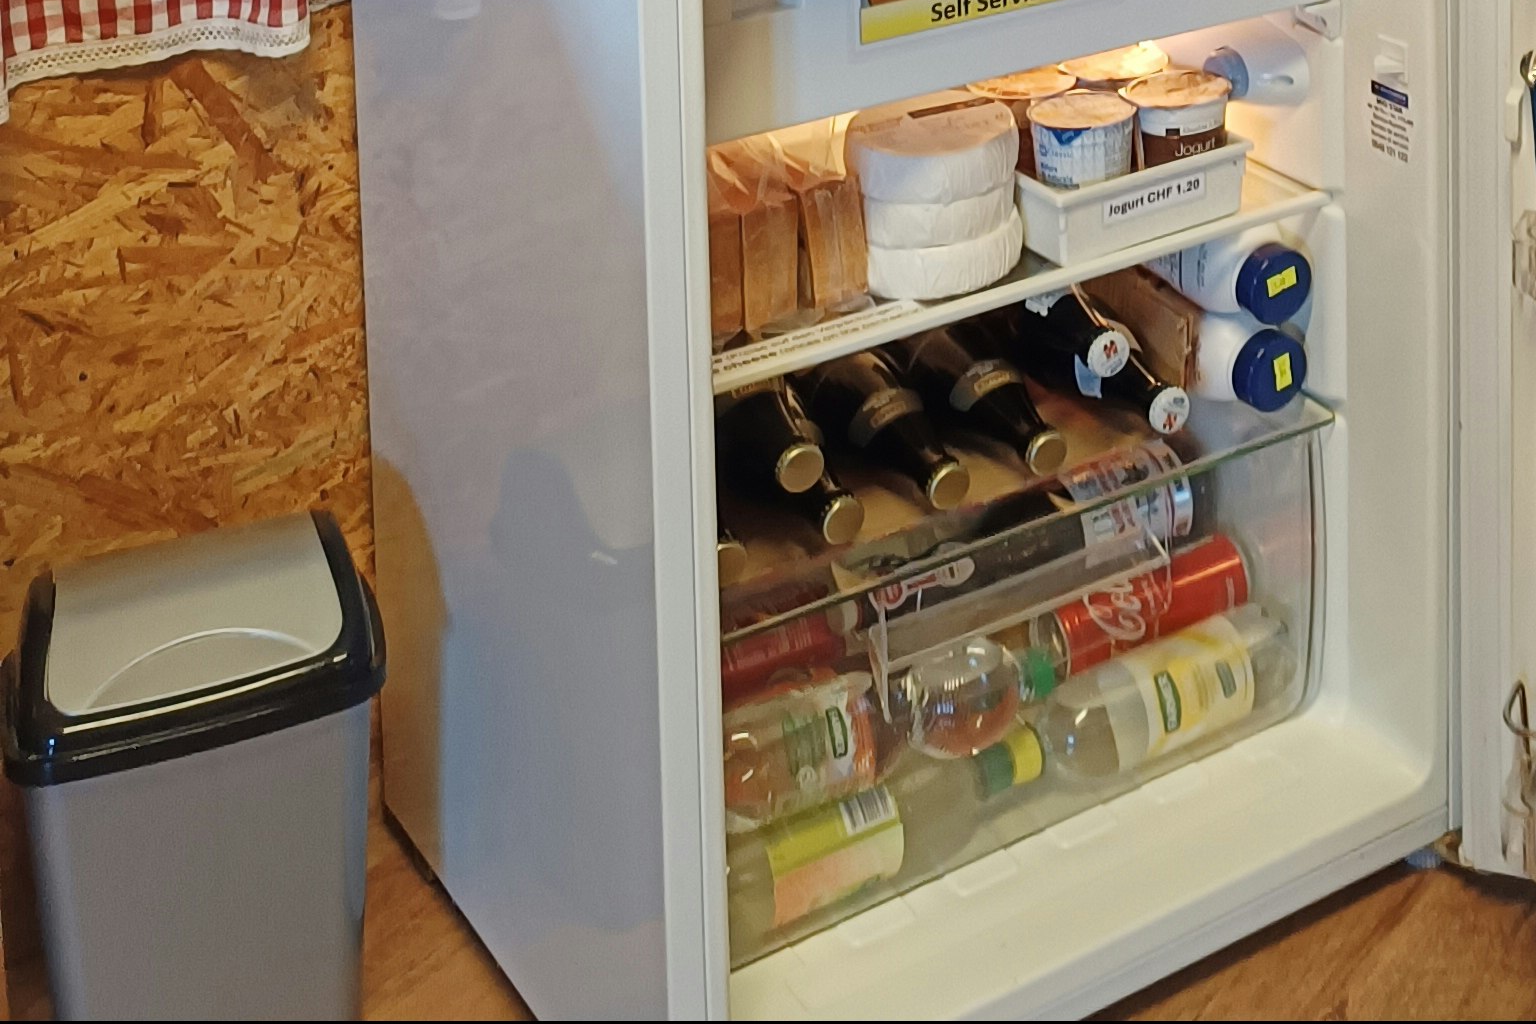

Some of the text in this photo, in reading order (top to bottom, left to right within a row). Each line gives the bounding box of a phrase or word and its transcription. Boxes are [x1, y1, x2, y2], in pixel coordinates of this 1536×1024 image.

[1174, 137, 1216, 159] Jogurt
[1108, 178, 1200, 217] Jogurt CHF 1.20
